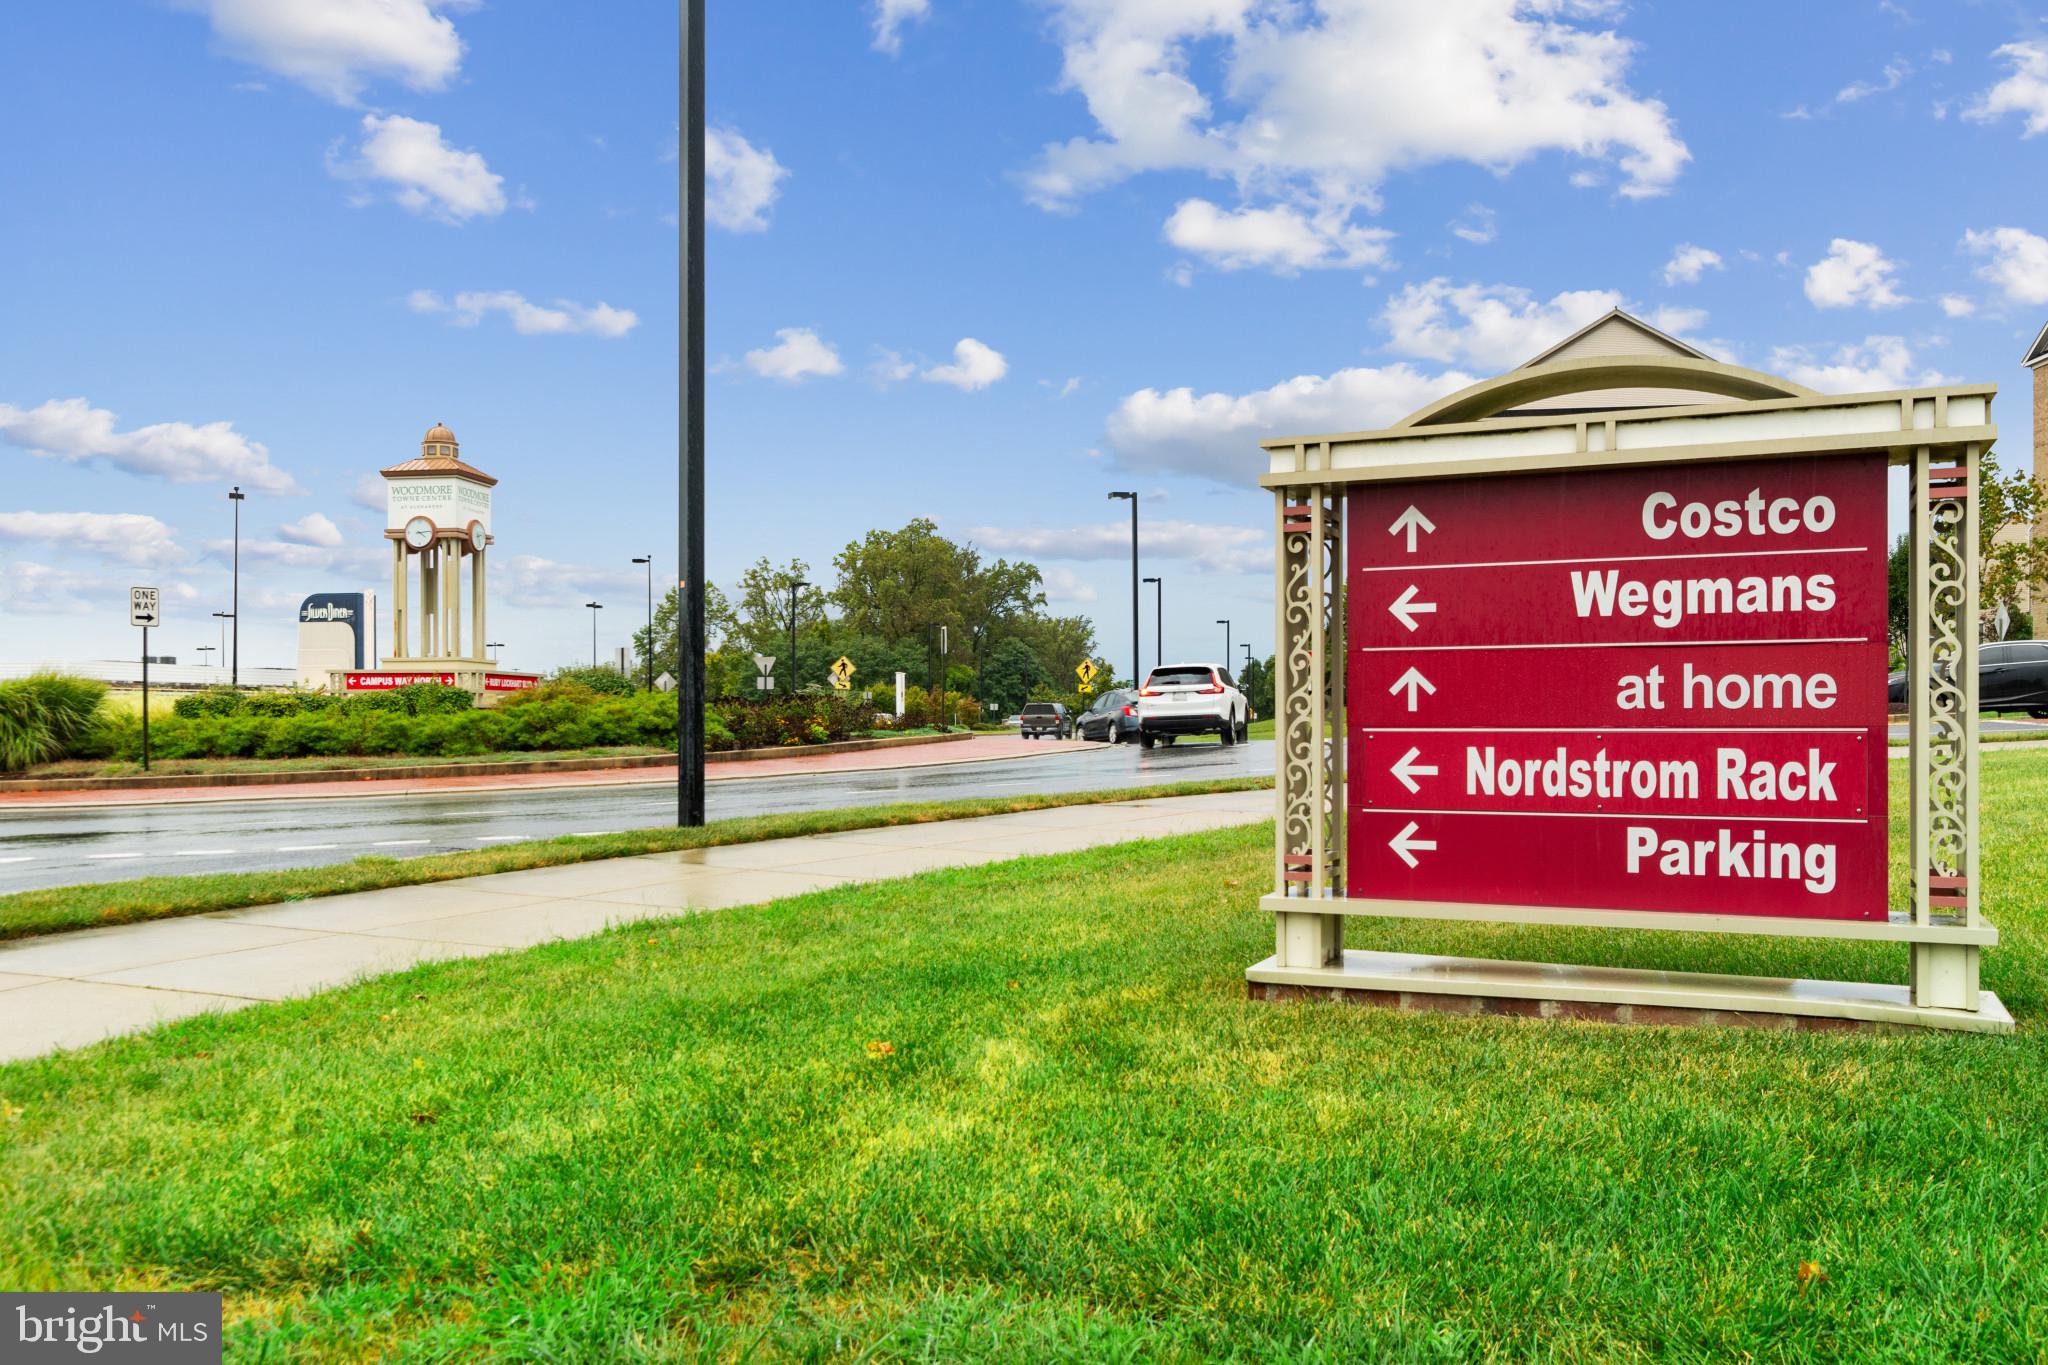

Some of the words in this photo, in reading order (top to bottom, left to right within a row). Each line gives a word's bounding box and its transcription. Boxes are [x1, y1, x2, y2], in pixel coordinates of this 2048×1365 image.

[392, 485, 453, 495] WOODMORE
[1643, 488, 1835, 540] Costco
[134, 590, 156, 600] ONE
[134, 601, 156, 610] WAY
[1571, 570, 1836, 628] Wegmans
[360, 676, 393, 686] CAMPUS
[395, 676, 413, 686] WAY
[1617, 665, 1664, 709] at
[1684, 663, 1837, 709] home
[1467, 747, 1698, 798] Nordstrom
[1718, 748, 1837, 801] Rack
[1627, 827, 1836, 894] Parking
